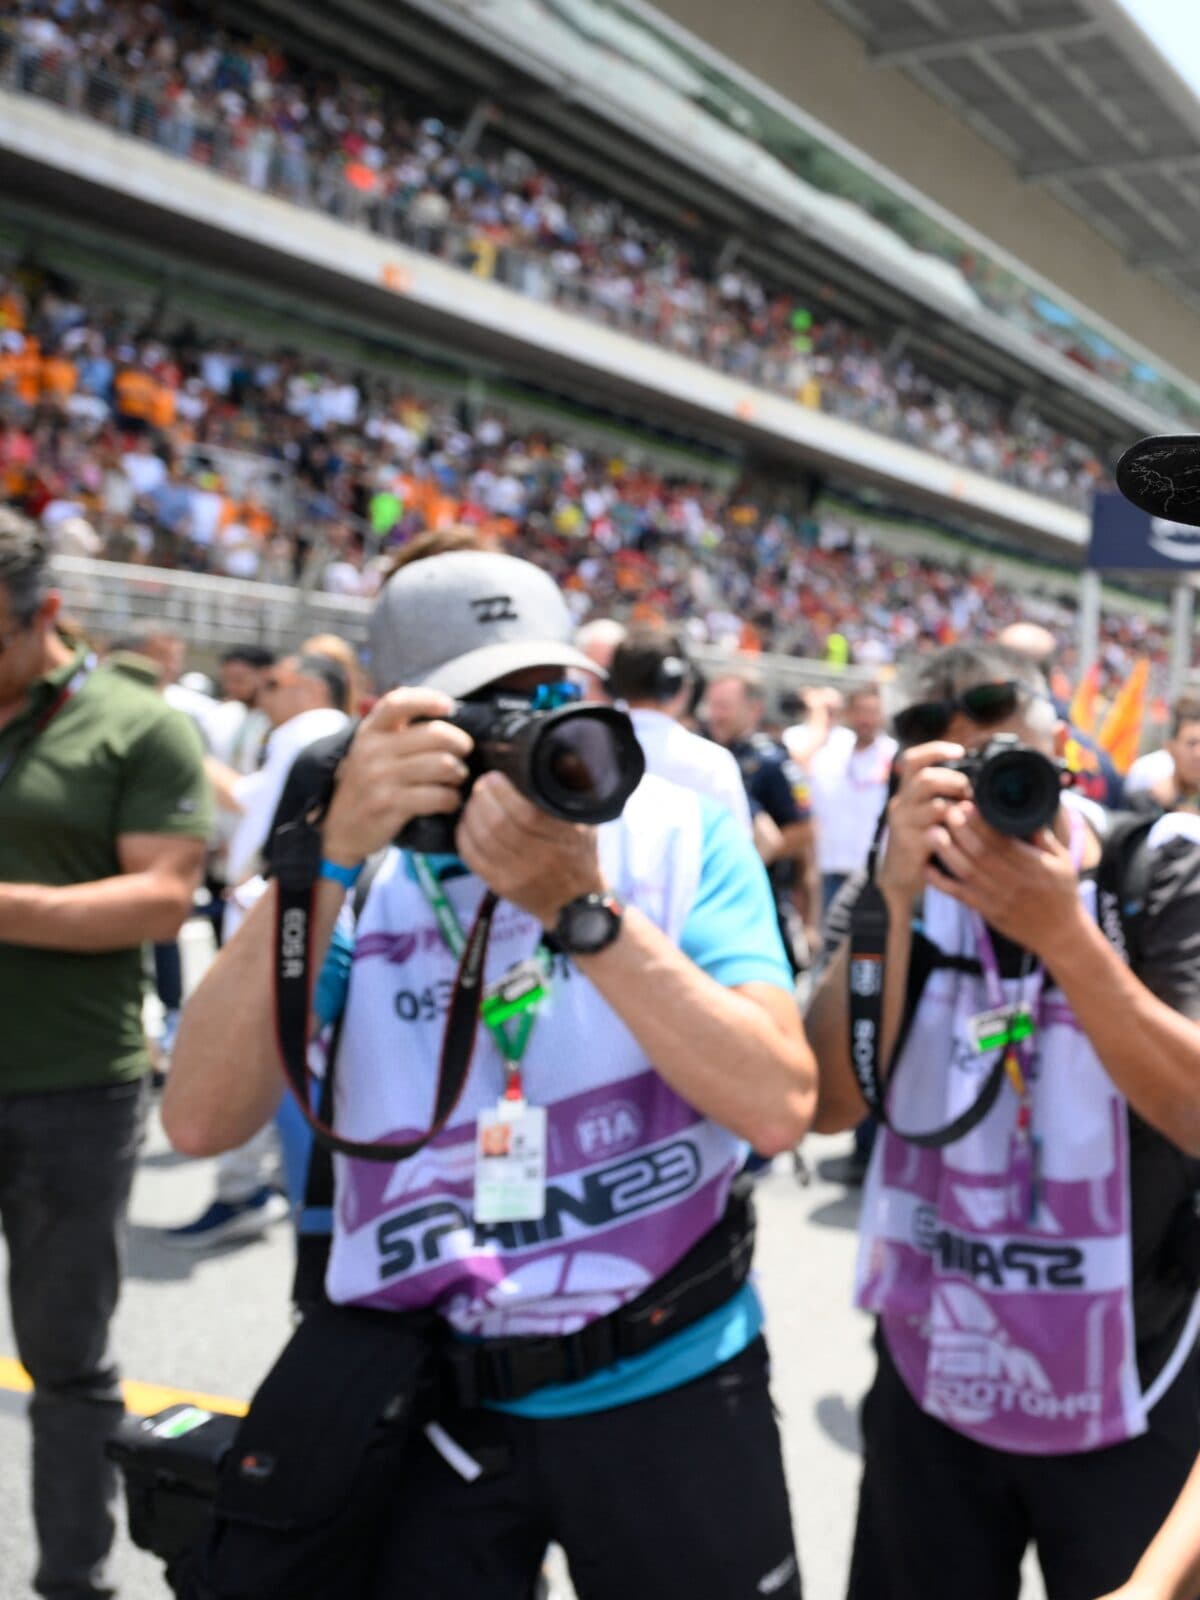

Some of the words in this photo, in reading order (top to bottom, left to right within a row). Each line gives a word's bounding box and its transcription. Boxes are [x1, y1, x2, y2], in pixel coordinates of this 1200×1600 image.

[282, 907, 306, 957] EOS
[853, 1019, 877, 1105] SONY
[576, 1111, 638, 1152] FIA
